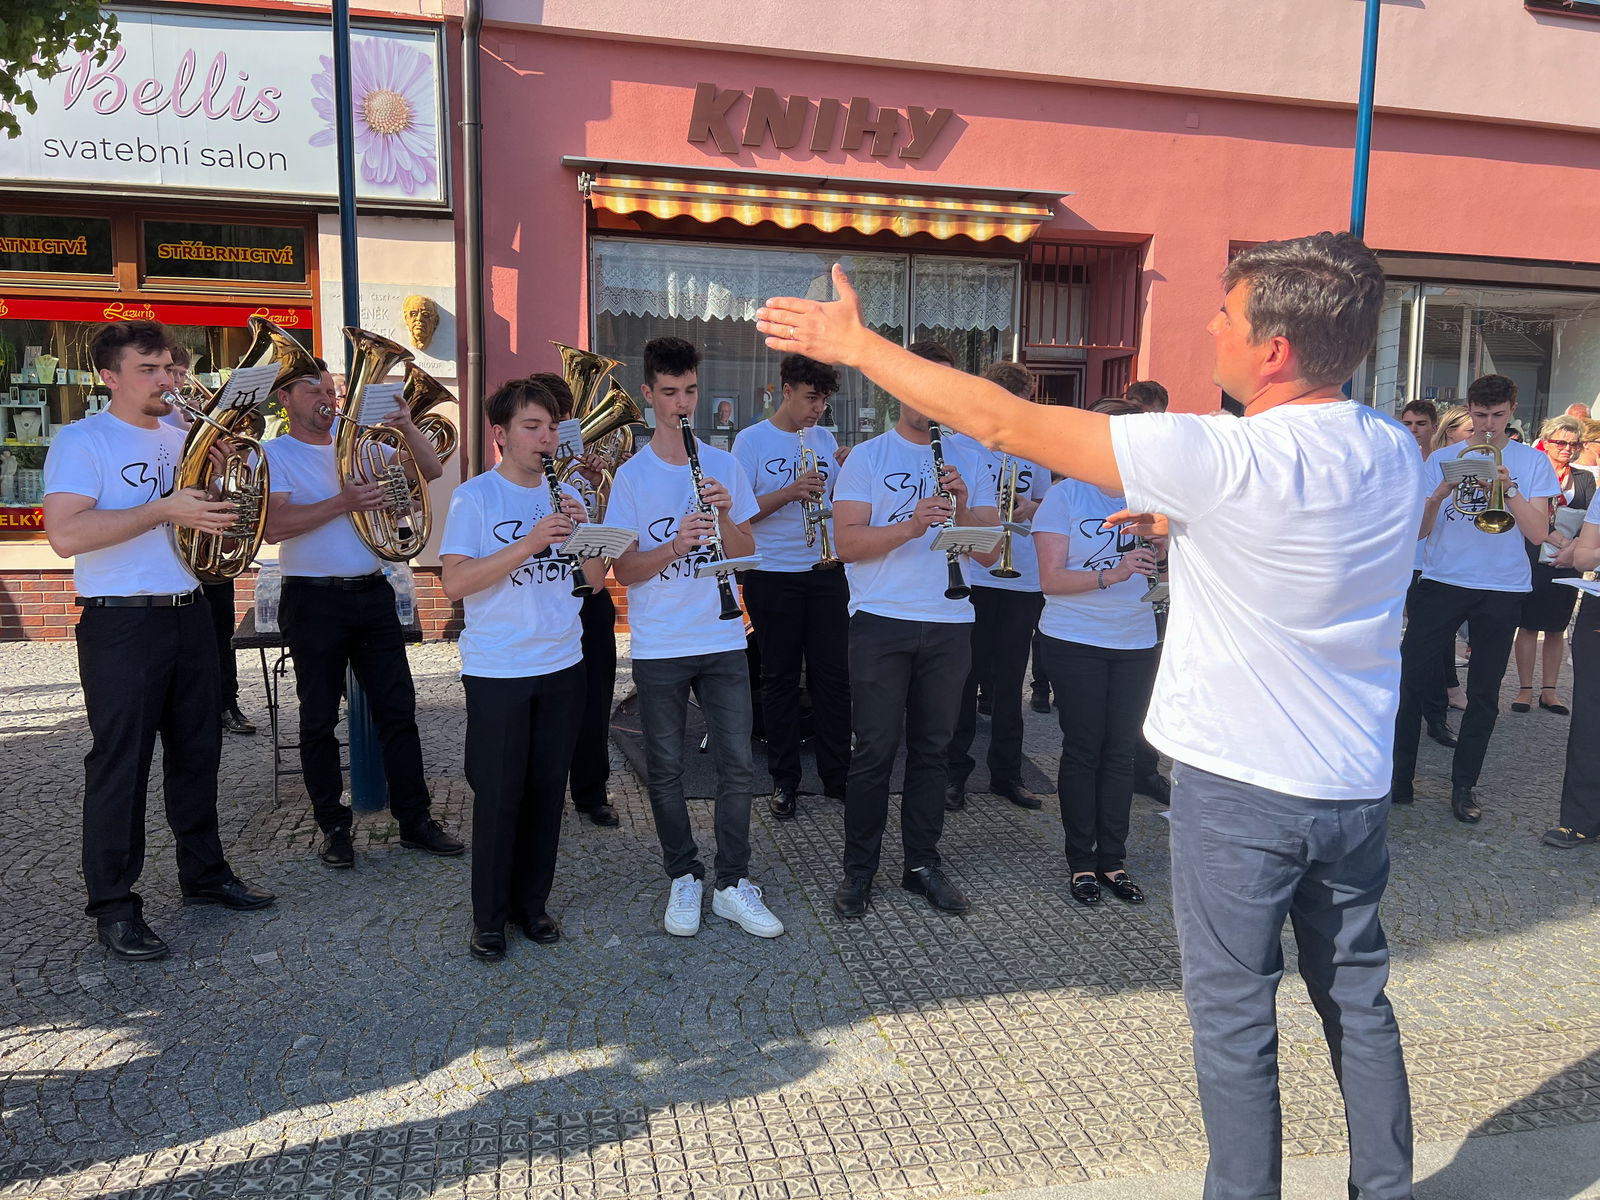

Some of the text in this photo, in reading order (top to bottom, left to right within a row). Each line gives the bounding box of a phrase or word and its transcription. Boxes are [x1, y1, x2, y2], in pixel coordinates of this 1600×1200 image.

[62, 43, 282, 123] Bellis
[687, 82, 953, 159] KNIHY
[44, 137, 287, 172] svatební salon
[158, 240, 293, 264] STŘÍBRNICTVÍ
[103, 302, 155, 321] Lazurit
